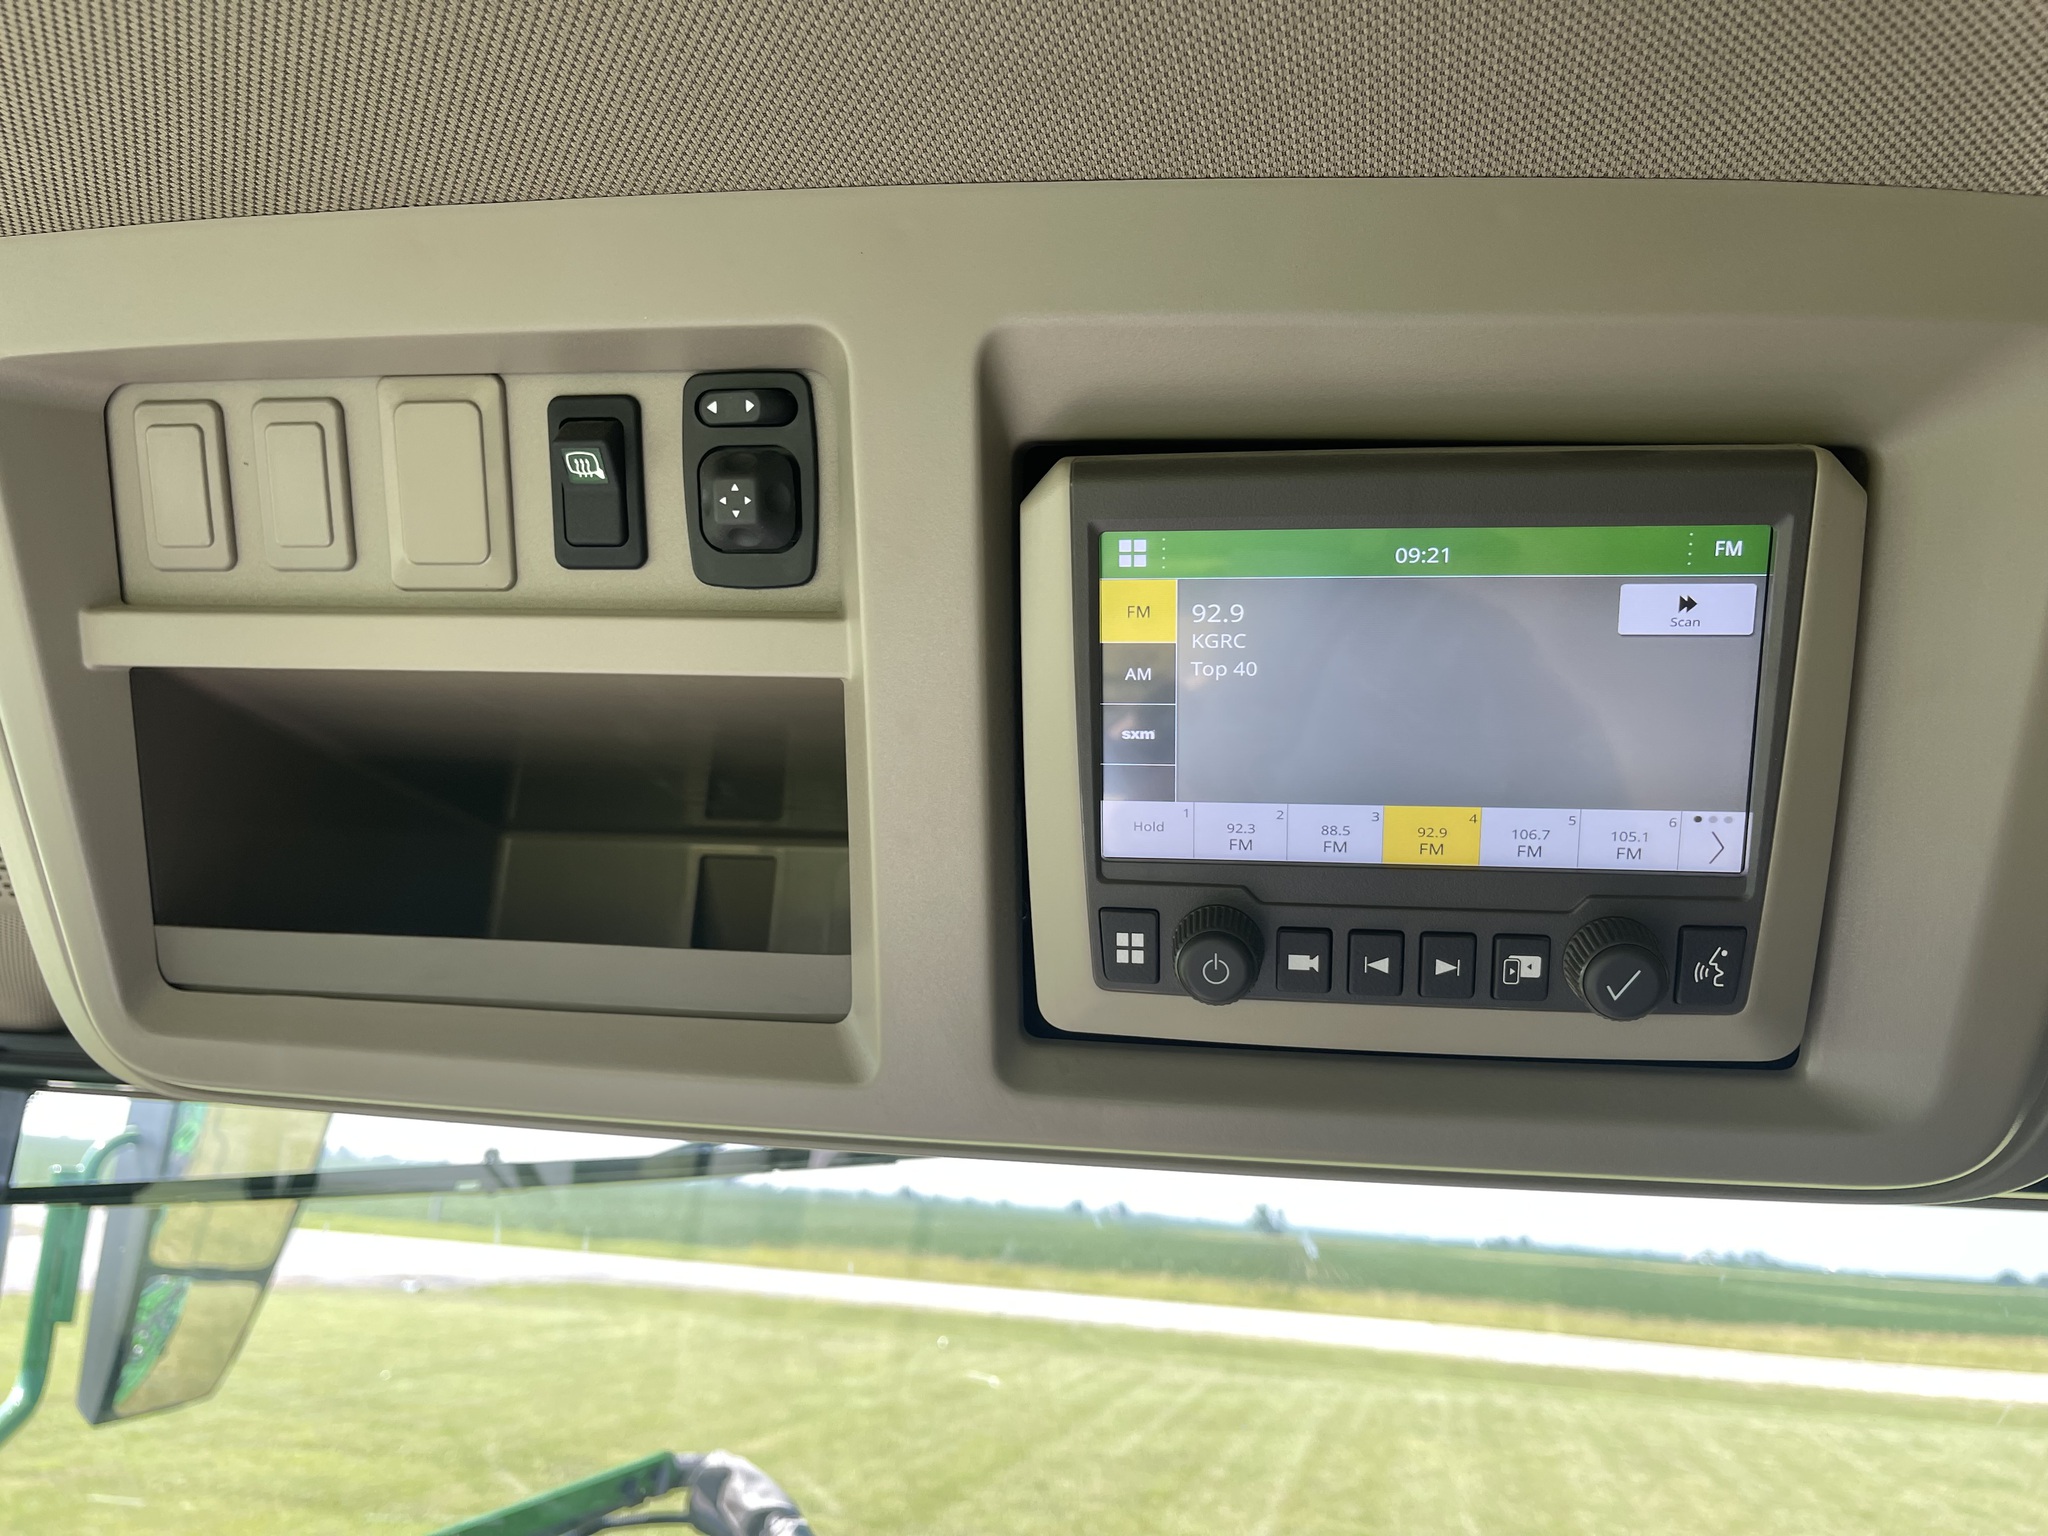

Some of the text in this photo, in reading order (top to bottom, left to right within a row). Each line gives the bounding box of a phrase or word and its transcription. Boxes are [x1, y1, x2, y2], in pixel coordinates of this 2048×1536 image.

[1714, 540, 1743, 557] FM
[1394, 547, 1450, 564] 09:21
[1126, 605, 1151, 618] FM
[1191, 603, 1244, 623] 92.9
[1669, 616, 1701, 628] Scan
[1191, 633, 1247, 649] KGRC
[1124, 667, 1152, 681] AM
[1190, 661, 1258, 681] Top 40
[1121, 729, 1156, 740] sxm
[1182, 808, 1189, 818] 1
[1275, 810, 1284, 820] 2
[1370, 812, 1380, 822] 3
[1468, 813, 1478, 824] 4
[1133, 821, 1165, 833] Hold
[1567, 815, 1577, 826] 5
[1668, 817, 1678, 828] 6
[1226, 823, 1256, 835] 92.3
[1320, 825, 1351, 837] 88.5
[1416, 827, 1448, 839] 92.9
[1511, 828, 1551, 841] 106.7
[1610, 830, 1649, 843] 105.1
[1228, 838, 1253, 851] FM
[1323, 840, 1348, 853] FM
[1419, 842, 1444, 856] FM
[1516, 844, 1542, 858] FM
[1615, 847, 1642, 861] FM
